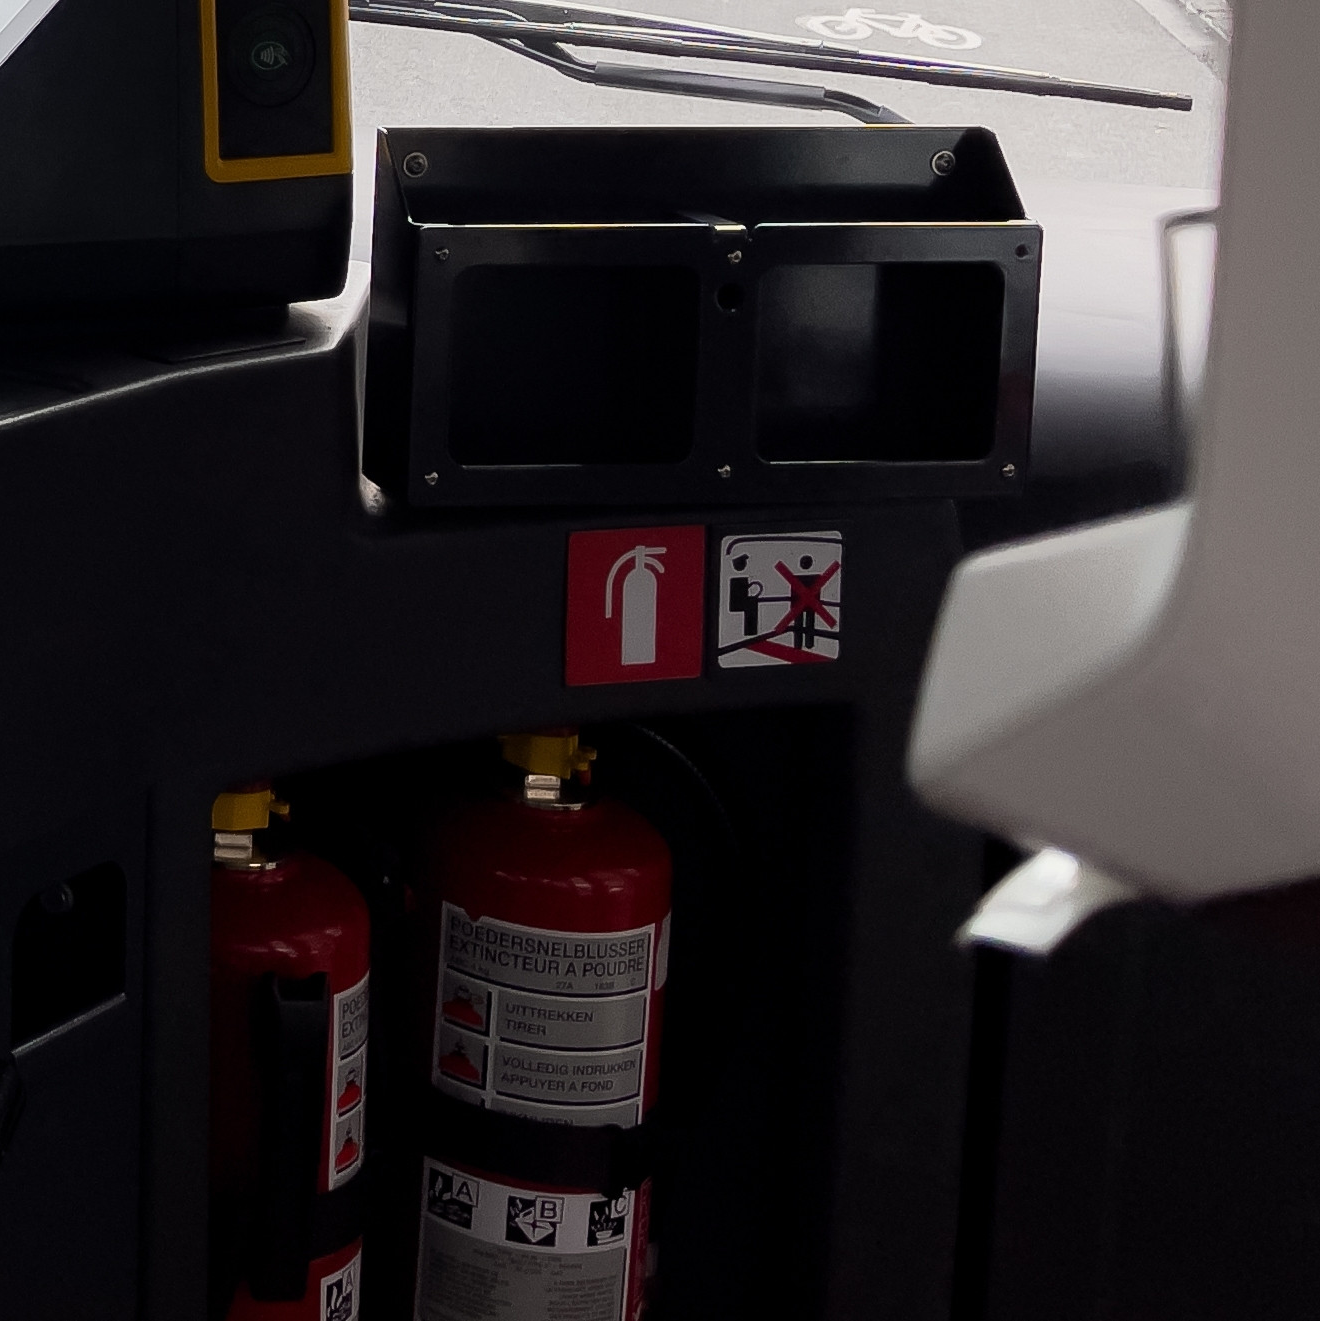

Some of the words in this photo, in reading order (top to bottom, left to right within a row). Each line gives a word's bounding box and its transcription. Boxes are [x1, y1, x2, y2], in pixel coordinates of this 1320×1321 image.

[450, 915, 646, 959] POEDERSNELBLUSSER
[449, 935, 560, 975] EXTINCTEUR
[565, 962, 577, 977] A
[582, 956, 645, 978] POUDRE
[505, 1002, 594, 1023] UITTREKKEN
[505, 1019, 548, 1037] TIRER
[502, 1055, 569, 1075] VOLLEDIG
[572, 1058, 637, 1077] INDRUKKEN
[500, 1072, 566, 1092] APPUYER
[569, 1079, 580, 1093] A
[580, 1079, 614, 1093] FOND
[457, 1180, 473, 1203] A
[540, 1200, 558, 1220] B
